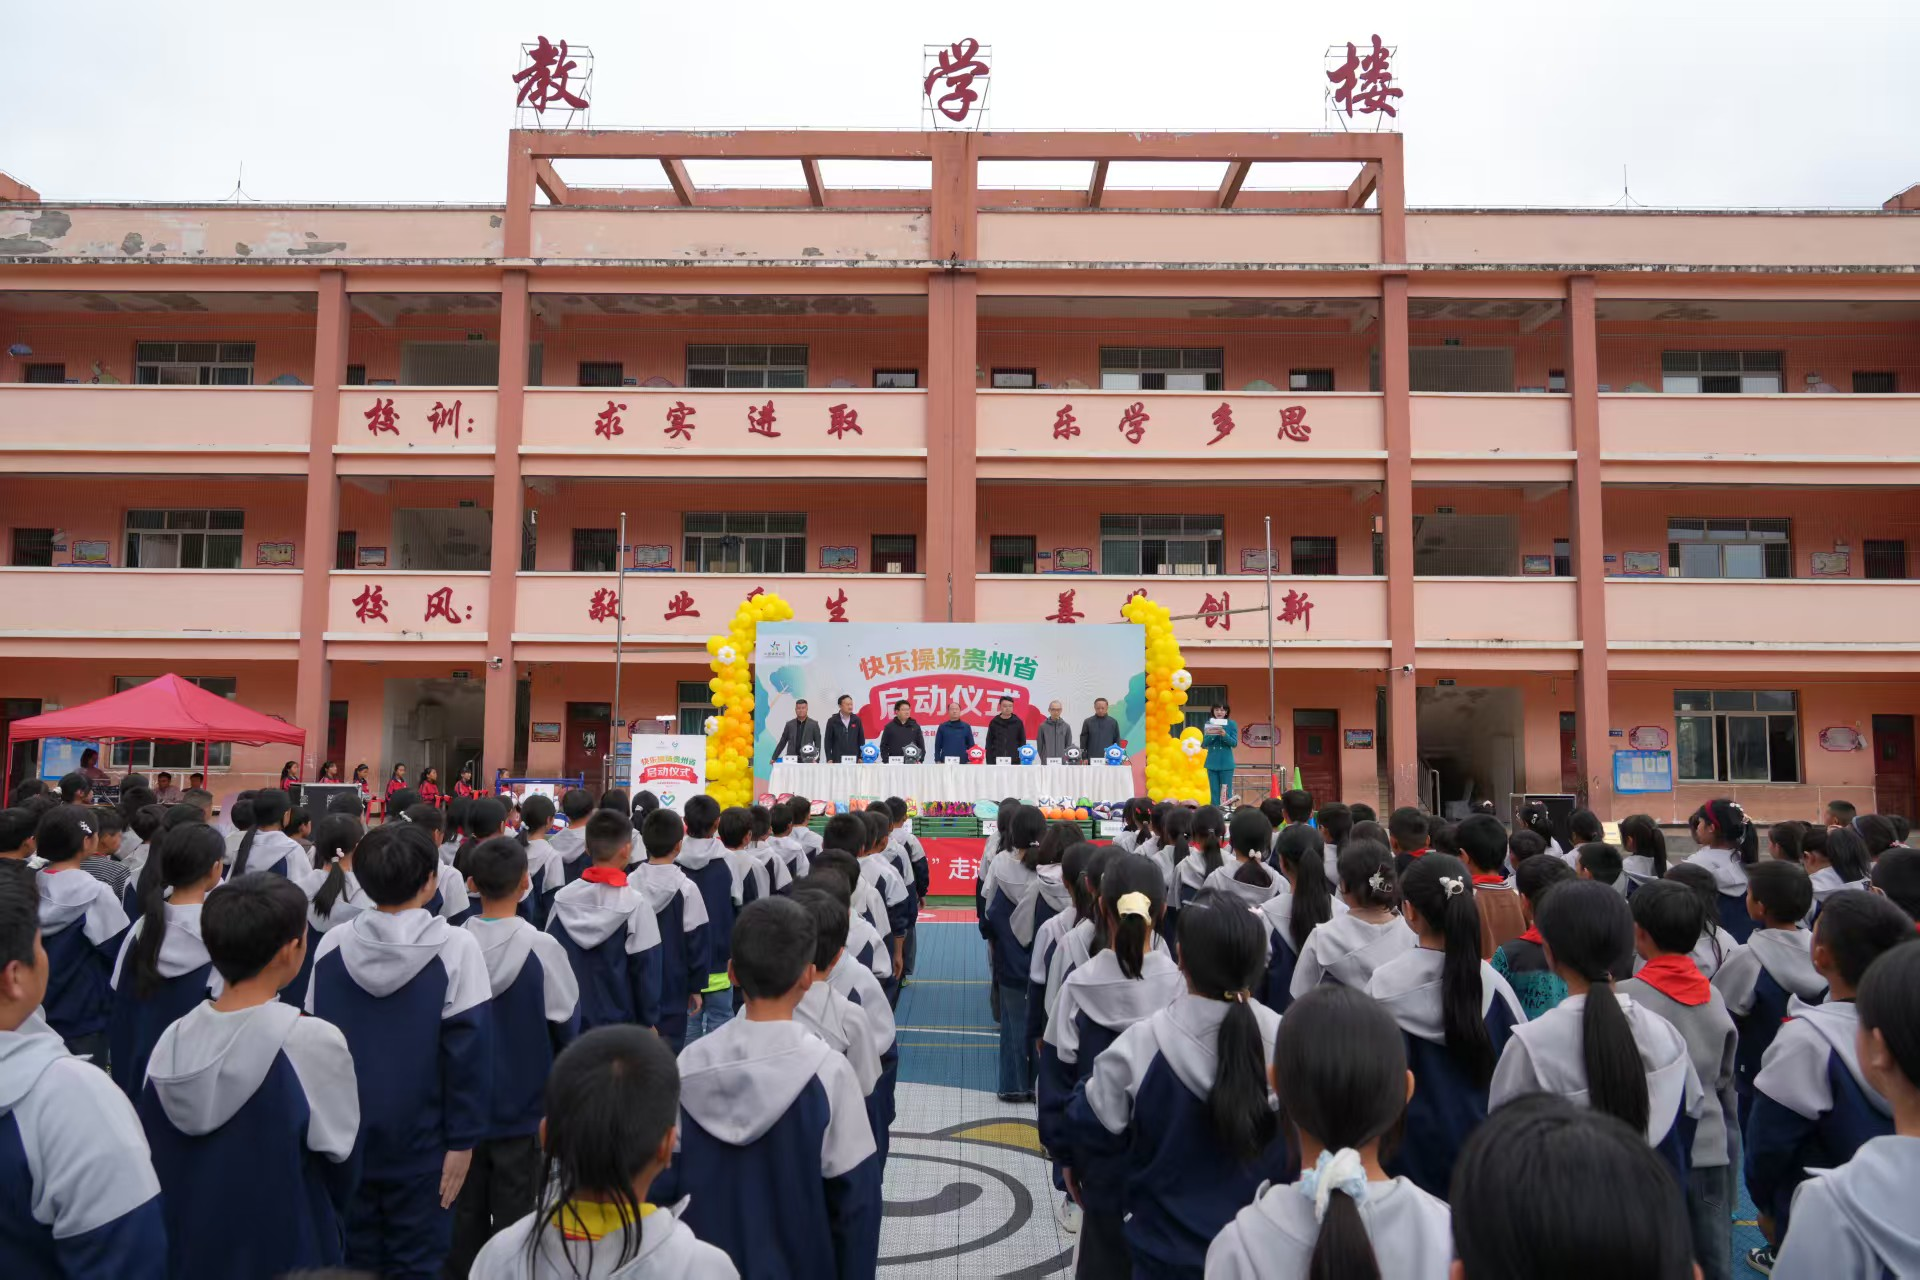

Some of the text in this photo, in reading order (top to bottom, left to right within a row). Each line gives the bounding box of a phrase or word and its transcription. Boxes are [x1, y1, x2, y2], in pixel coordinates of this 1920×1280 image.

[513, 35, 1402, 122] 教学楼
[595, 401, 864, 441] 求实进取
[1053, 401, 1312, 446] 乐学多思
[859, 646, 1039, 681] 快乐操场贵州省
[878, 684, 1021, 721] 启动仪式
[647, 766, 690, 777] 启动仪式
